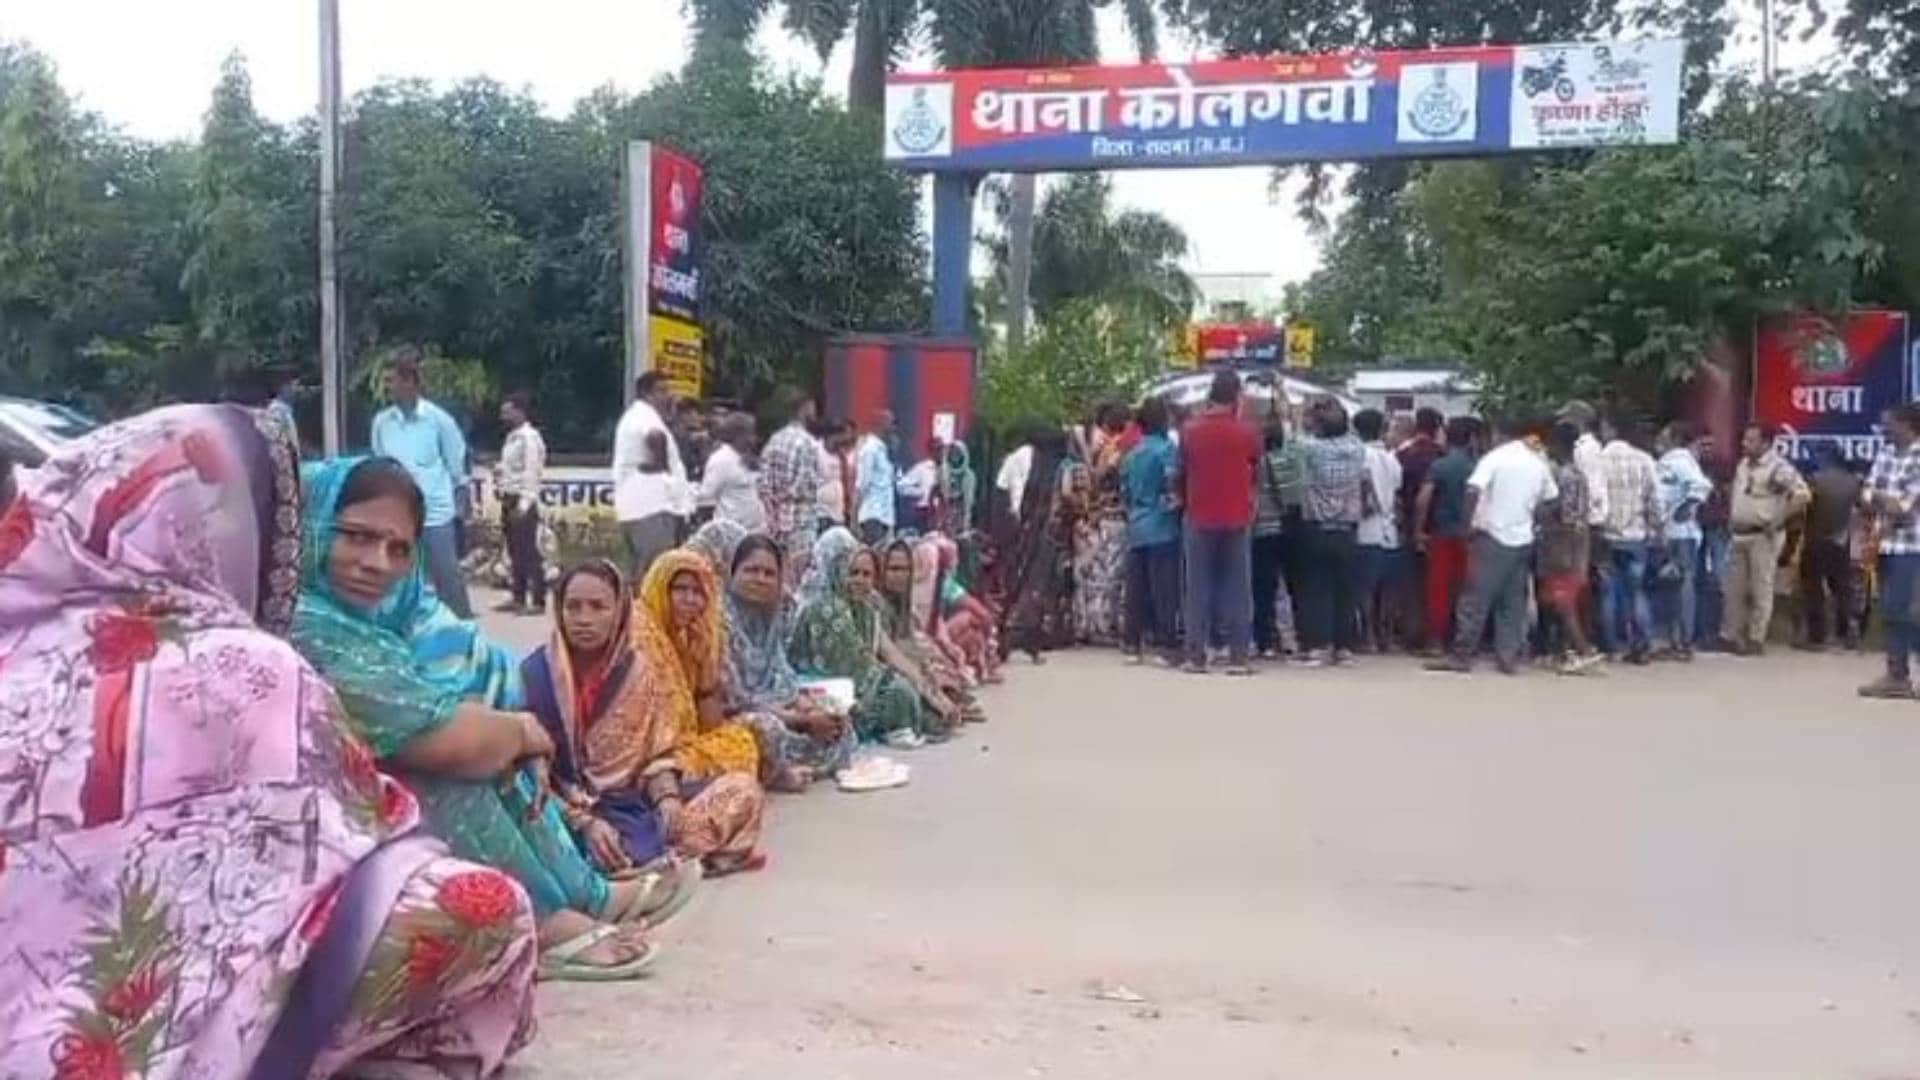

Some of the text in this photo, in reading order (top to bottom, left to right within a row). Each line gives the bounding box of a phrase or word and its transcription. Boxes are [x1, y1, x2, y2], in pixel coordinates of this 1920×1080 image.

[971, 60, 1377, 134] थाना कोलगवाँ
[1791, 385, 1864, 413] थाना
